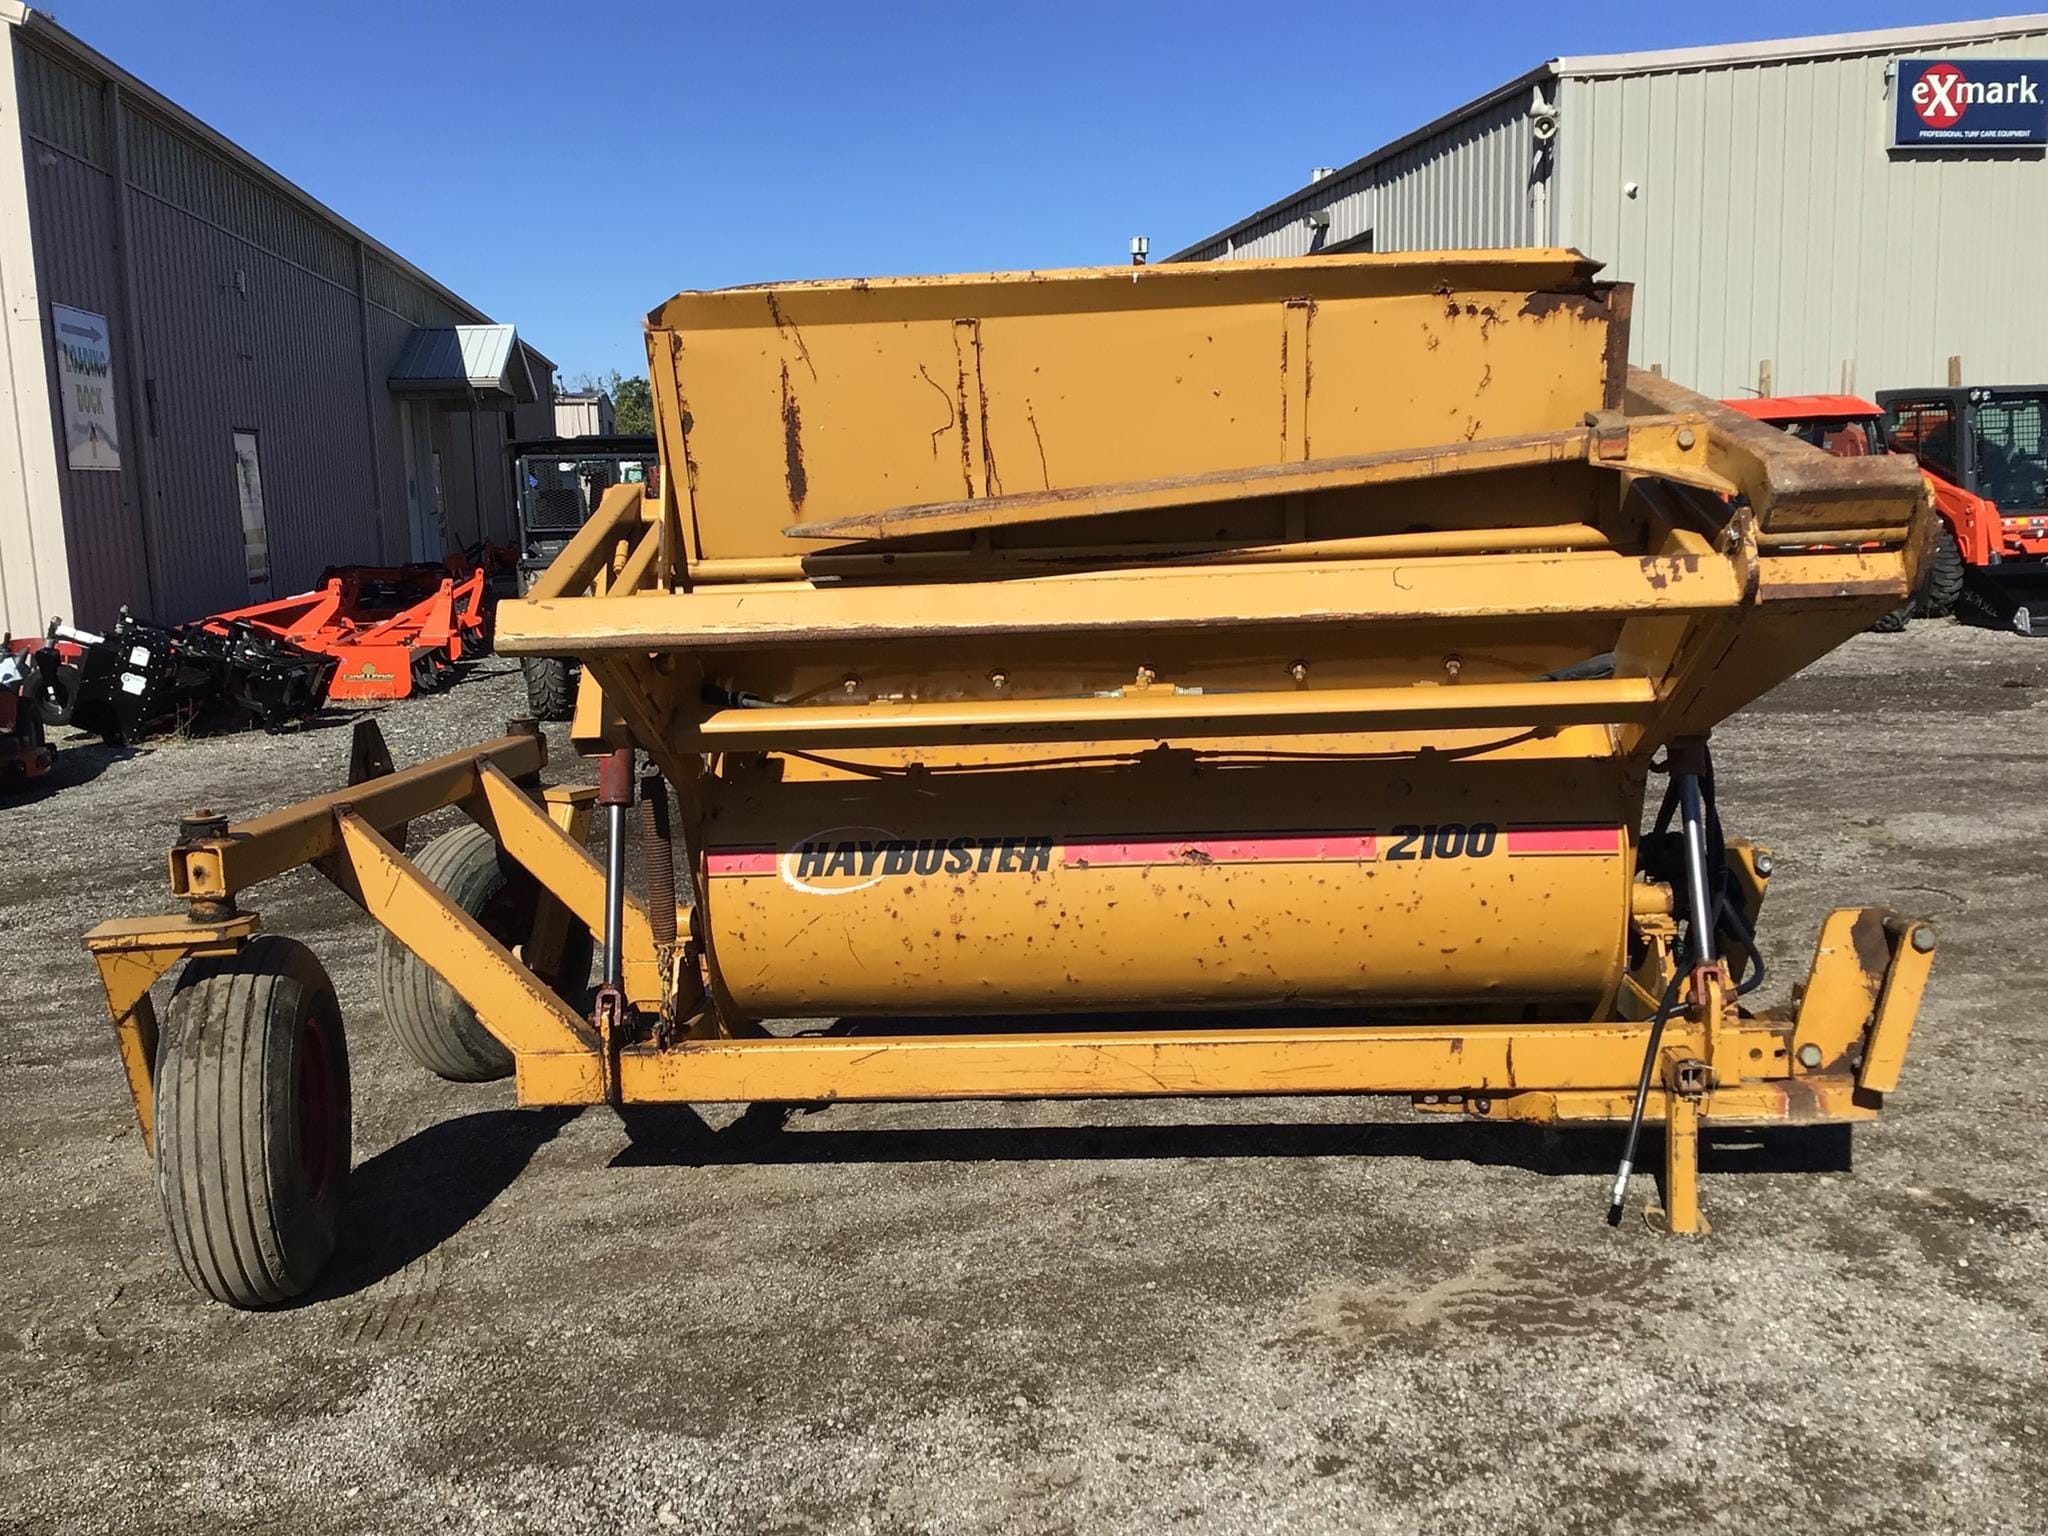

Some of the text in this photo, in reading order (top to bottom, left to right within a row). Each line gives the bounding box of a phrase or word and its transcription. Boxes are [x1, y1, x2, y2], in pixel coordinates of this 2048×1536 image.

[1919, 129, 2031, 138] PROFESSIONAL TURF CARE EQUIPMENT
[63, 343, 108, 379] LOADING
[76, 383, 105, 415] DOCK
[796, 836, 1055, 877] HAYBUSTER
[1386, 822, 1498, 861] 2100
